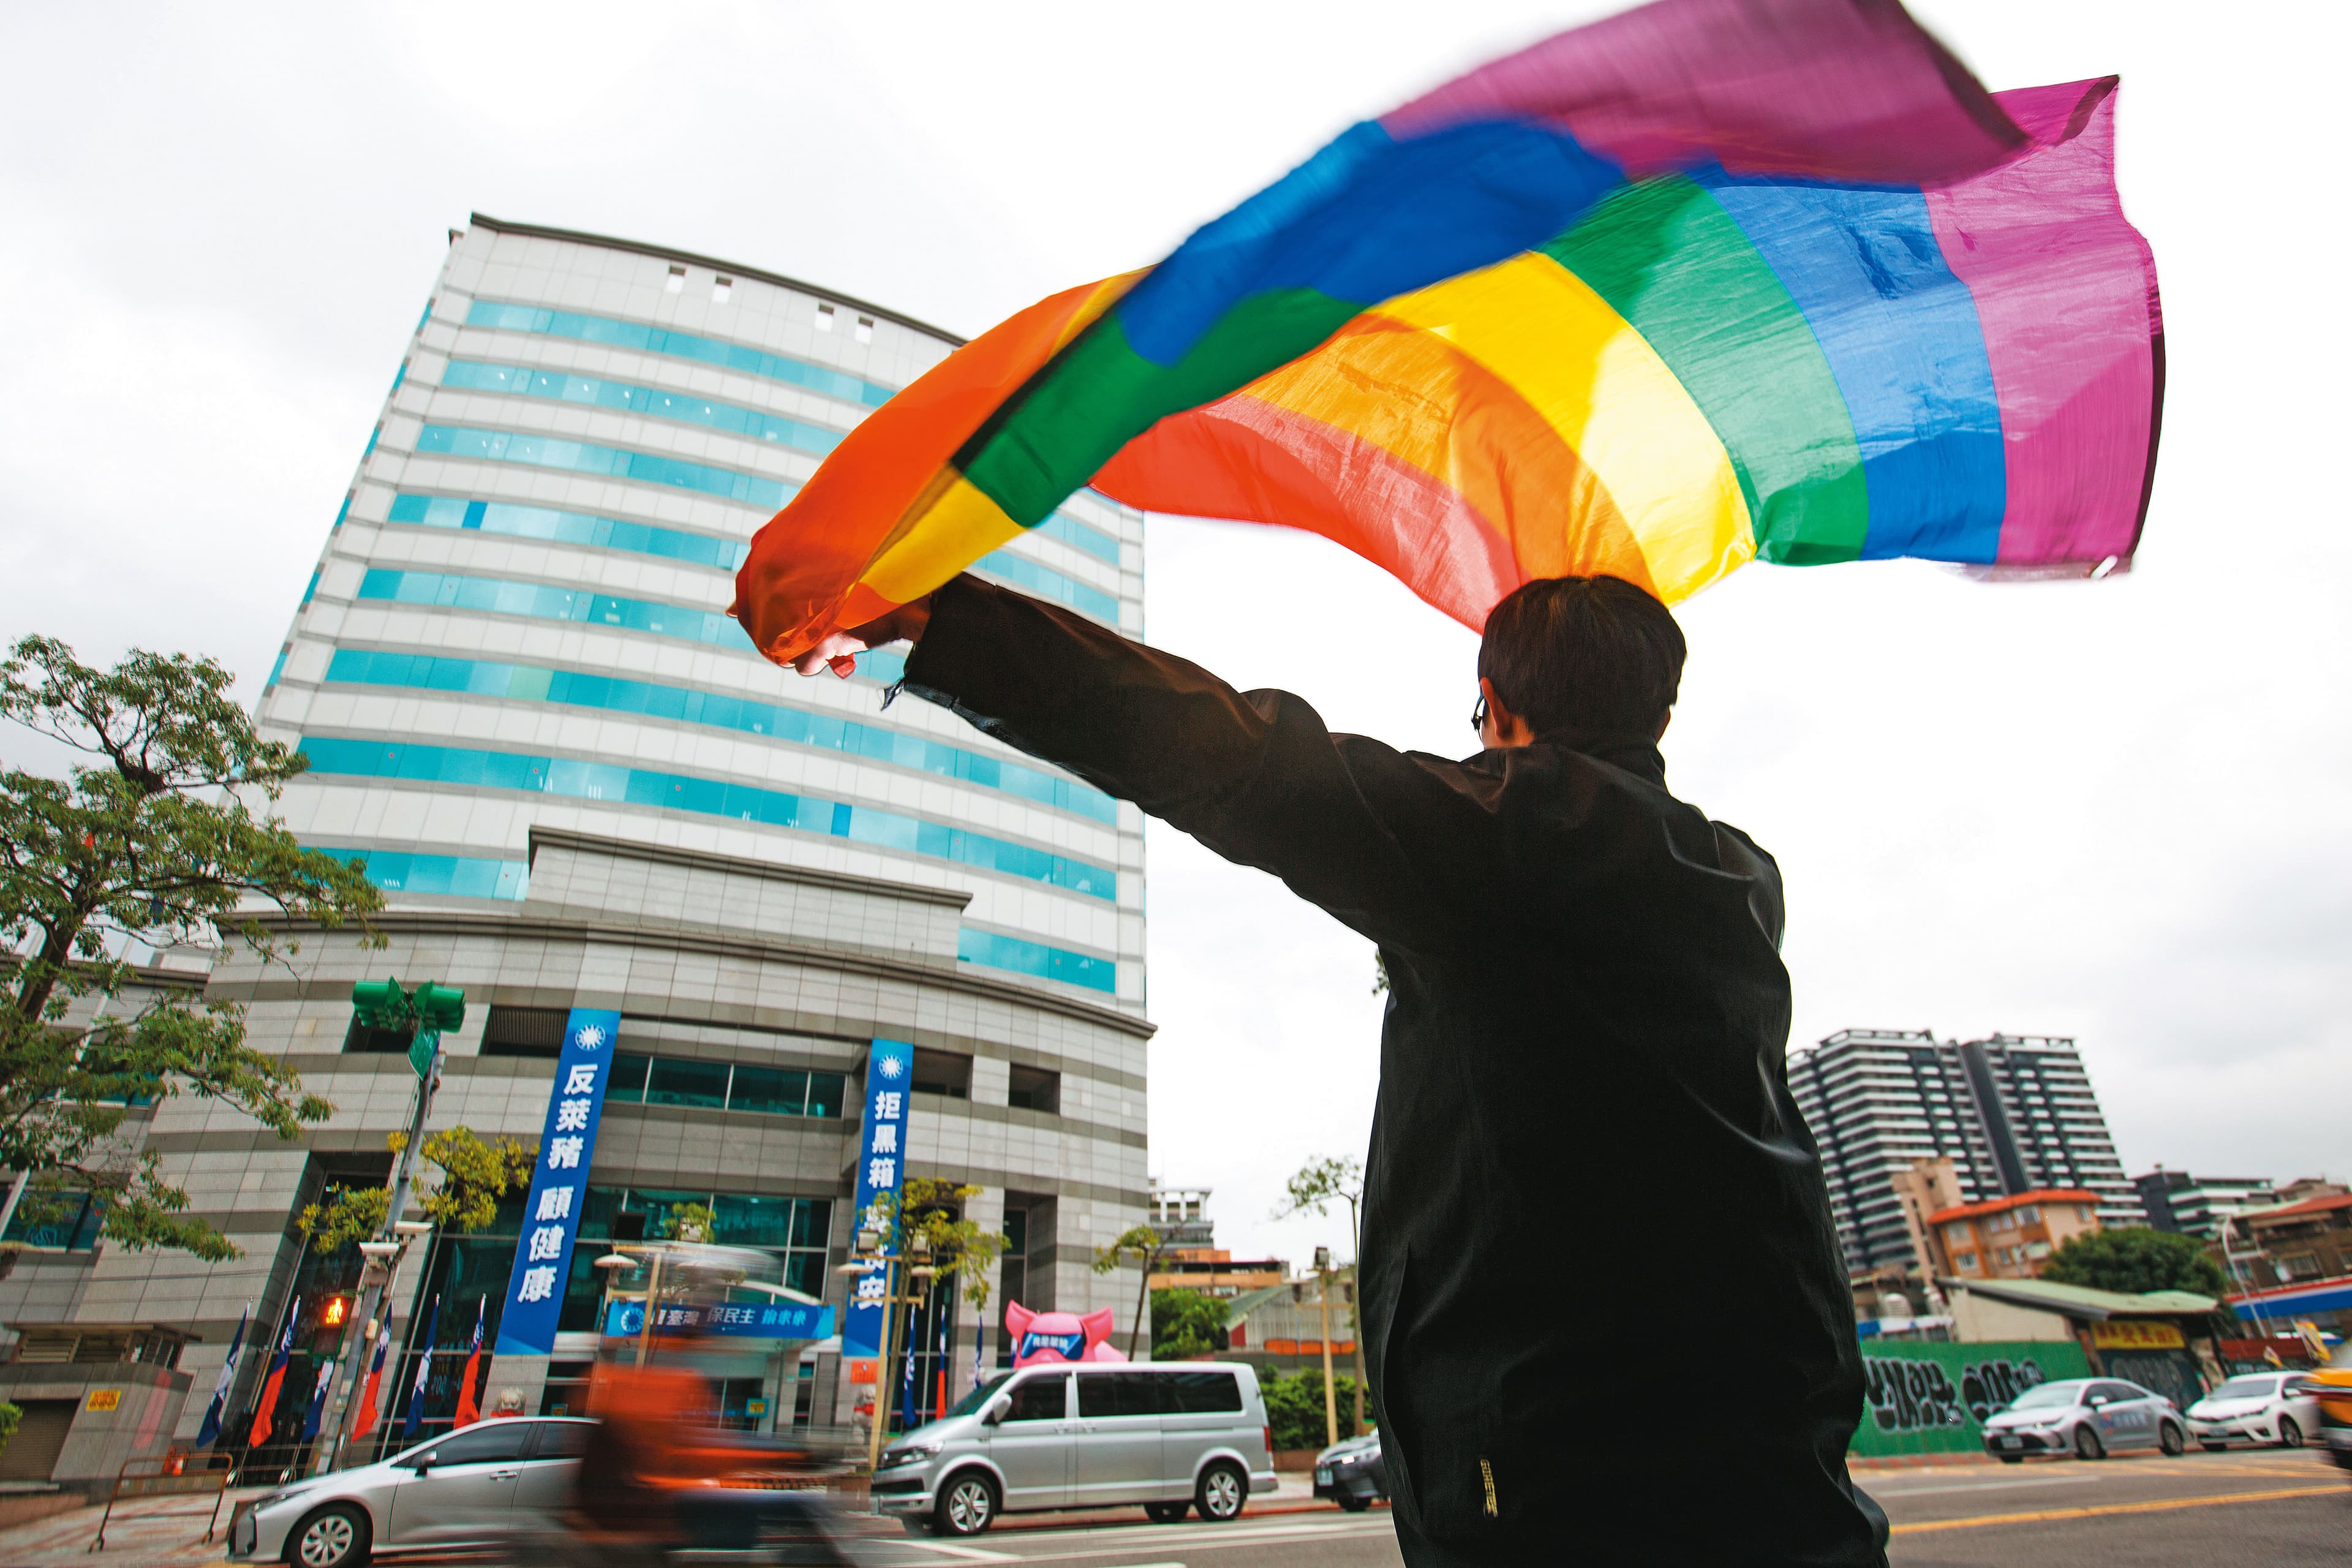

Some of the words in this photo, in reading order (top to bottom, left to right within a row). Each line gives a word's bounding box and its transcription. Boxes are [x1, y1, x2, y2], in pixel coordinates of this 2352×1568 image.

[548, 1063, 598, 1170] 反萊豬
[868, 1090, 902, 1189] 拒黑箱
[517, 1186, 575, 1303] 顧健康
